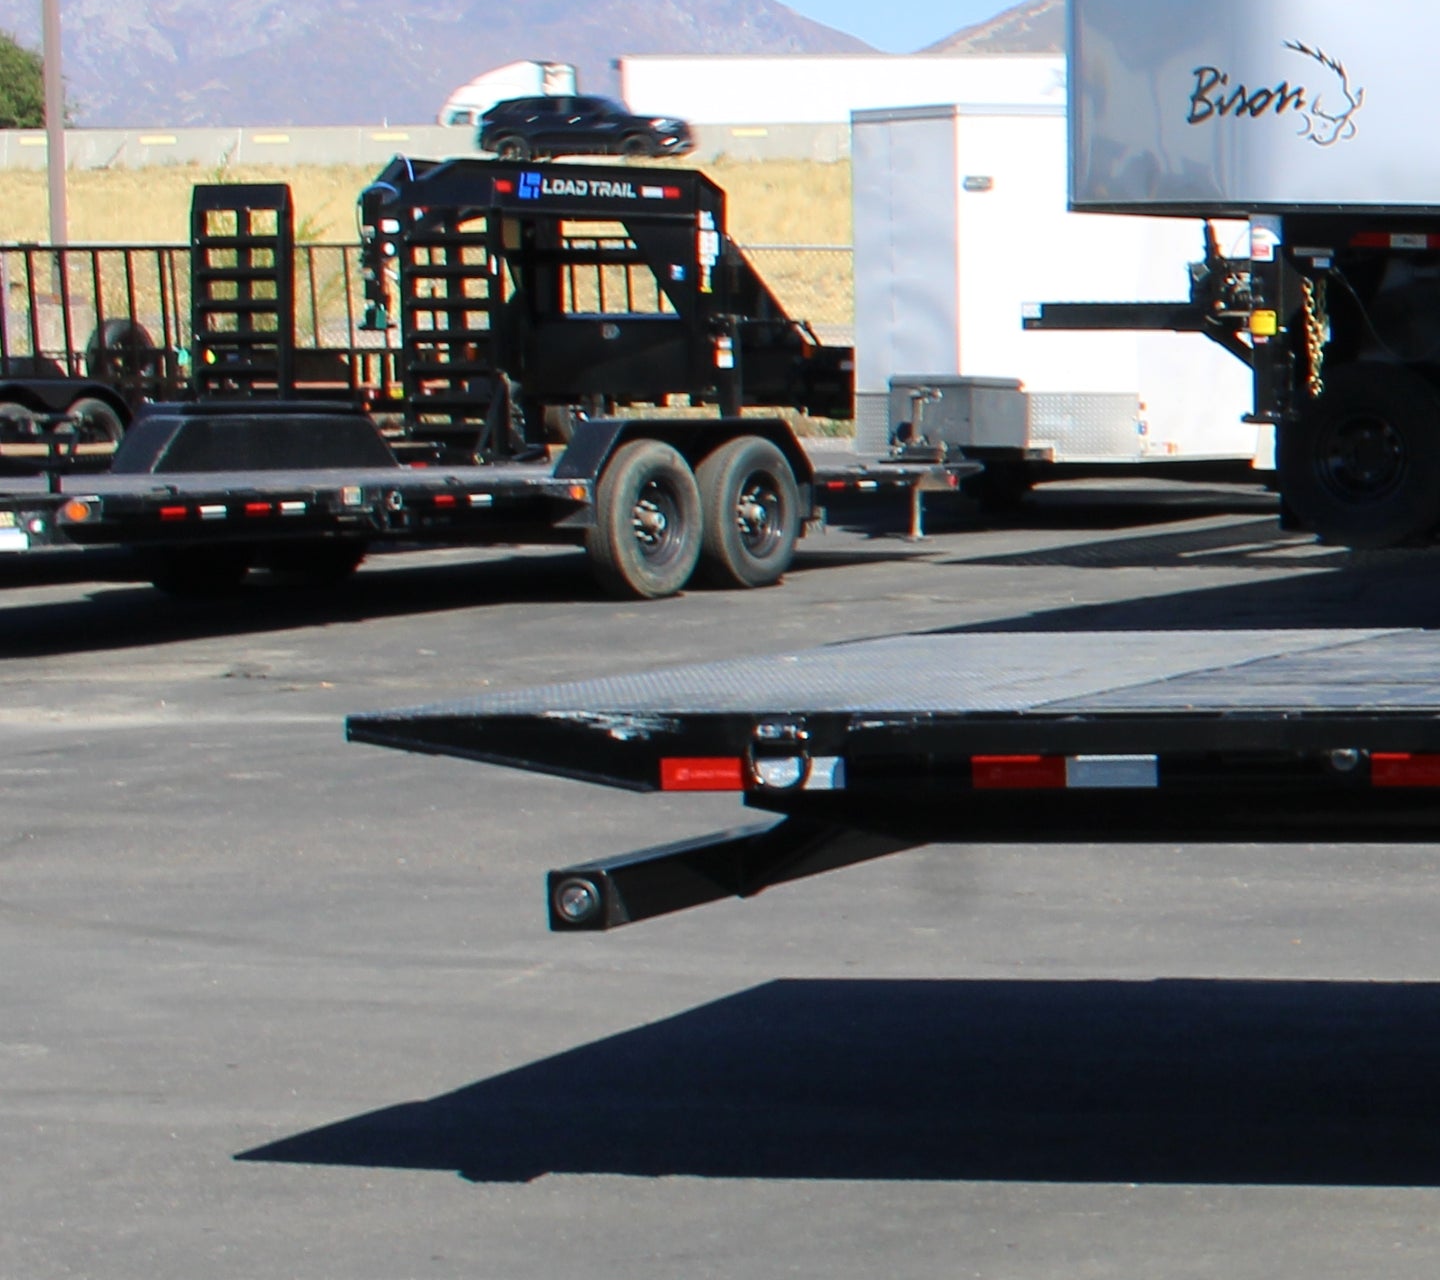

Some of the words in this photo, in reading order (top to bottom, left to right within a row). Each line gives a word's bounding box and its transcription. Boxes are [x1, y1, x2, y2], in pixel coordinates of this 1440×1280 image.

[1187, 66, 1306, 125] Bison
[542, 178, 588, 196] LOAD
[588, 180, 637, 199] TRAIL
